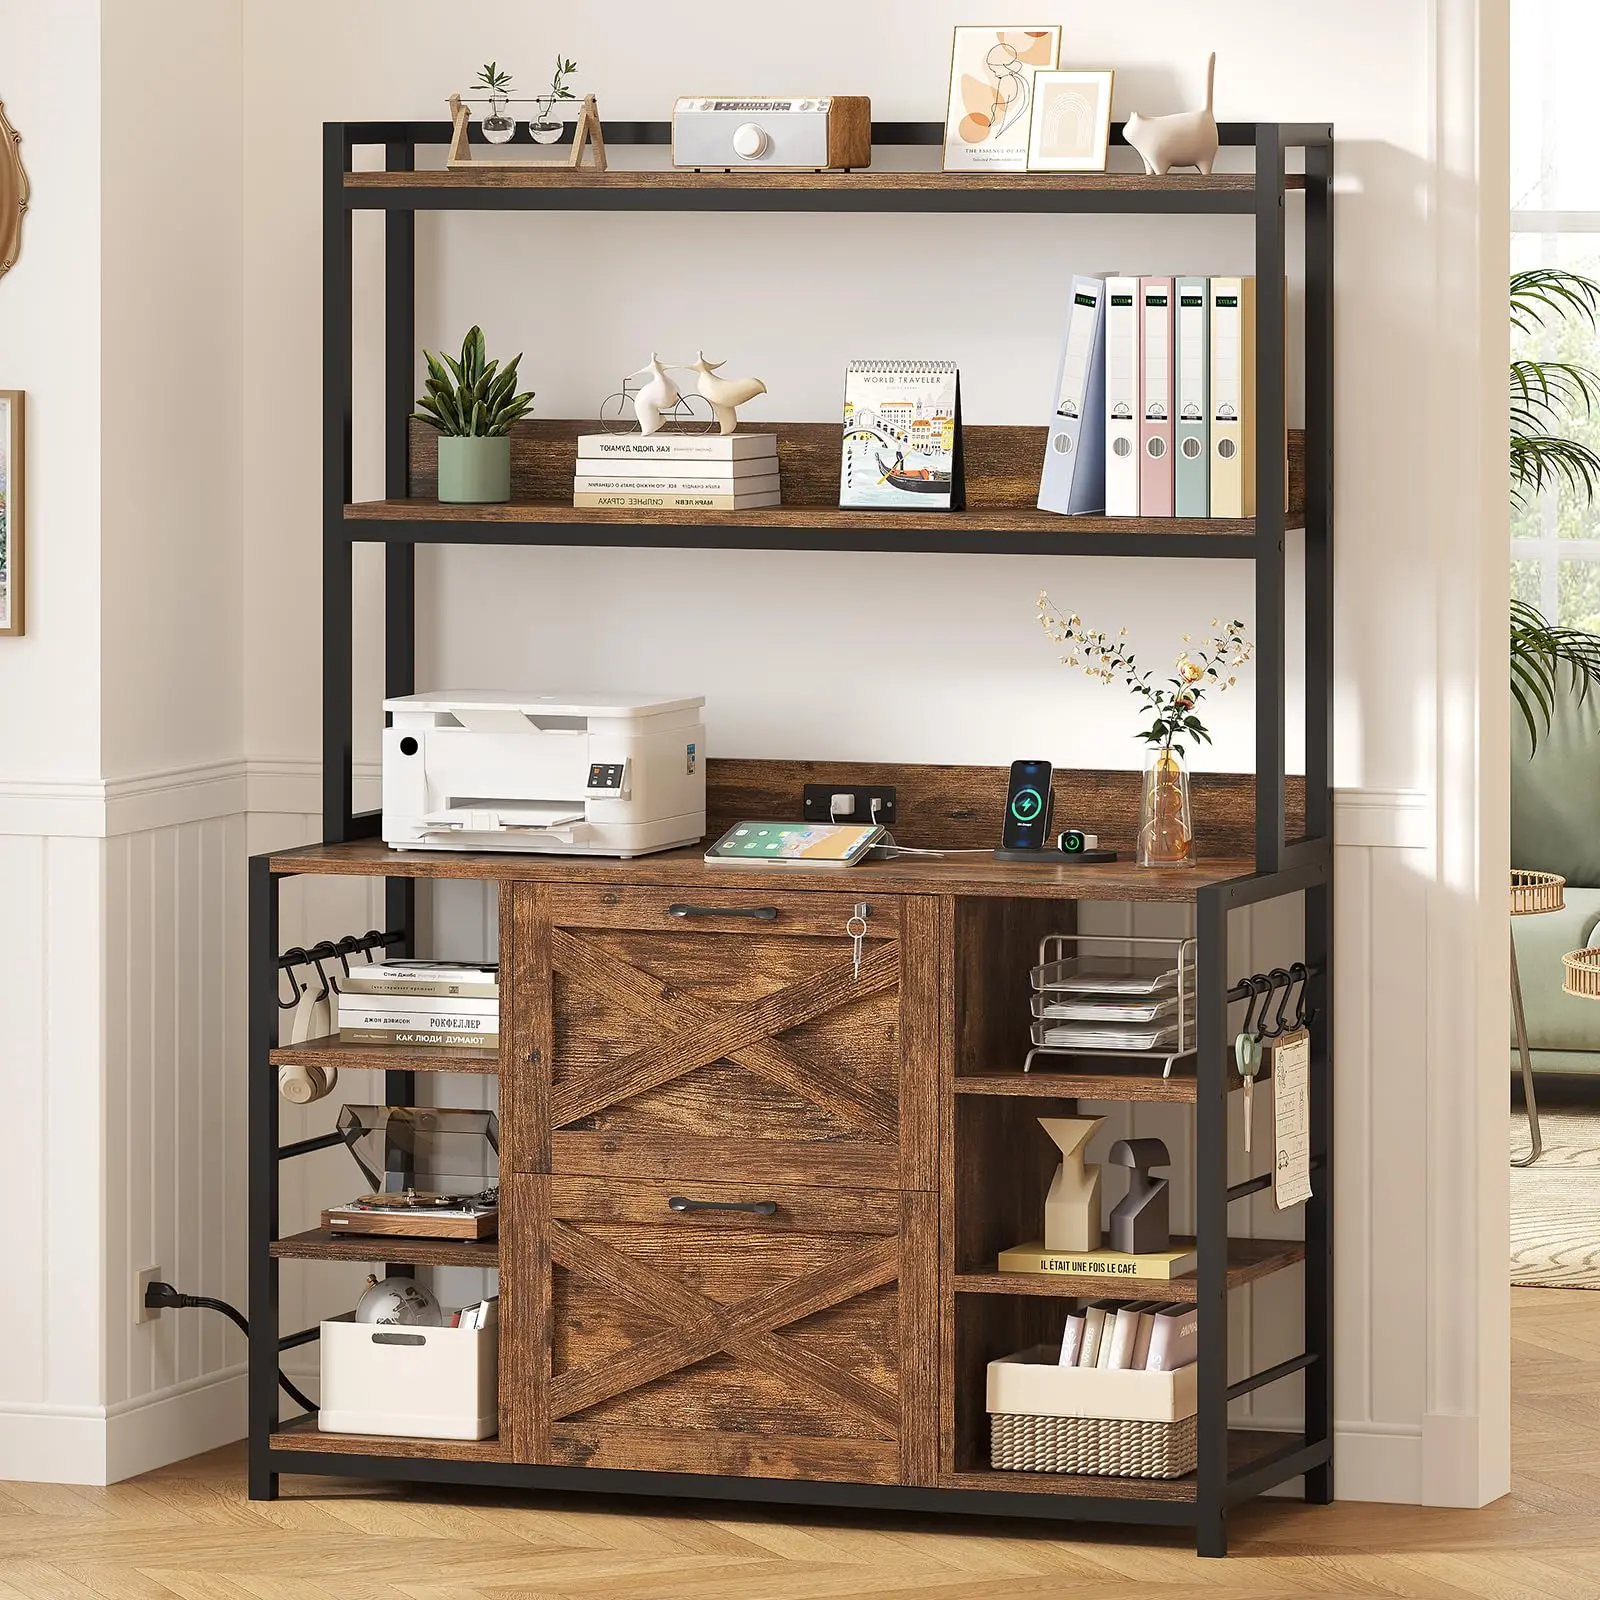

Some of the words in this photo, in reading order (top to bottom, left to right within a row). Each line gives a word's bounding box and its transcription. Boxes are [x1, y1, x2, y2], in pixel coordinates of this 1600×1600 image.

[864, 376, 894, 384] WORLD
[899, 376, 941, 384] TRAVELER
[430, 1018, 481, 1029] РОКФЕЛЛЕР
[396, 1033, 412, 1042] КАК
[415, 1034, 442, 1043] ЛЮДИ
[446, 1036, 484, 1045] ДУМАЮТ
[1041, 1259, 1048, 1270] IL
[1049, 1258, 1071, 1271] ÉTAIT
[1072, 1261, 1087, 1272] UNE
[1088, 1262, 1105, 1273] FOIS
[1107, 1263, 1116, 1273] LE
[1117, 1262, 1137, 1275] CAFÉ
